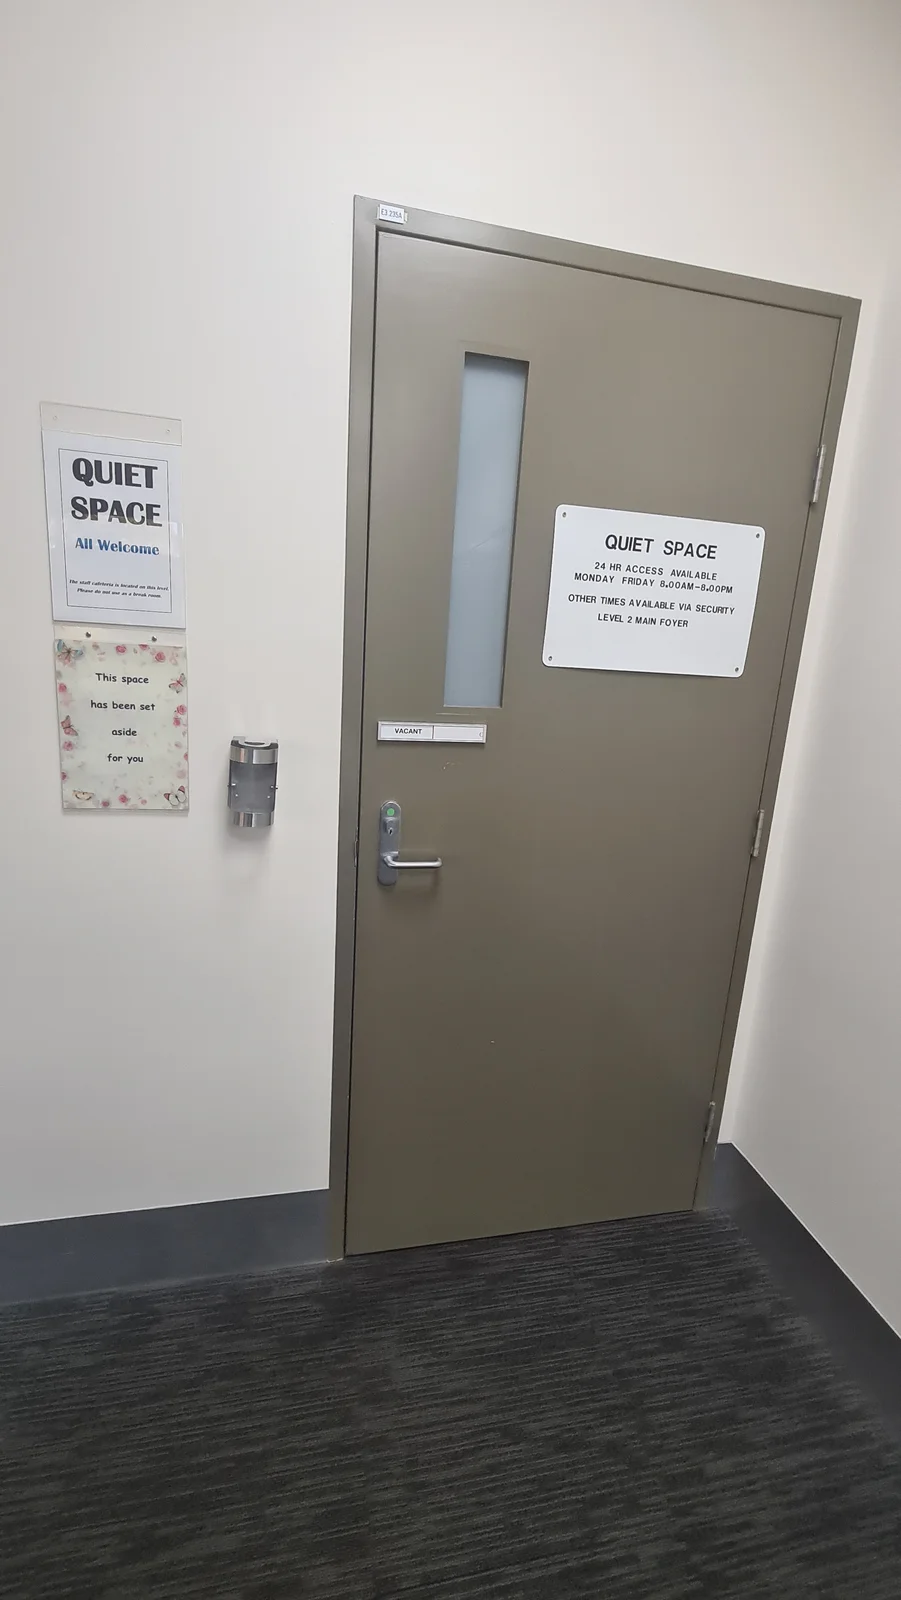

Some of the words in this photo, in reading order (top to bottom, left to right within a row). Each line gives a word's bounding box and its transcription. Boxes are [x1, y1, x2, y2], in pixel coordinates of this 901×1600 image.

[72, 458, 158, 488] QUIET
[71, 496, 162, 527] SPACE
[75, 538, 92, 549] All
[97, 539, 159, 555] Welcome
[605, 534, 654, 553] QUIET
[663, 540, 717, 559] SPACE
[595, 562, 605, 570] 24
[610, 563, 622, 571] HR
[625, 565, 663, 575] ACCESS
[670, 569, 717, 580] AVAILABLE
[574, 573, 614, 583] MONDAY
[622, 577, 654, 587] FRIDAY
[568, 594, 597, 603] OTHER
[600, 596, 626, 606] TIMES
[629, 599, 675, 610] AVAILABLE
[695, 604, 735, 615] SECURITY
[598, 614, 624, 622] LEVEL
[635, 617, 656, 625] MAIN
[660, 619, 688, 627] FOYER
[96, 673, 117, 682] This
[122, 676, 149, 685] space
[91, 700, 108, 708] has
[112, 701, 135, 710] been
[112, 728, 137, 736] aside
[107, 753, 123, 762] for
[127, 756, 143, 764] you
